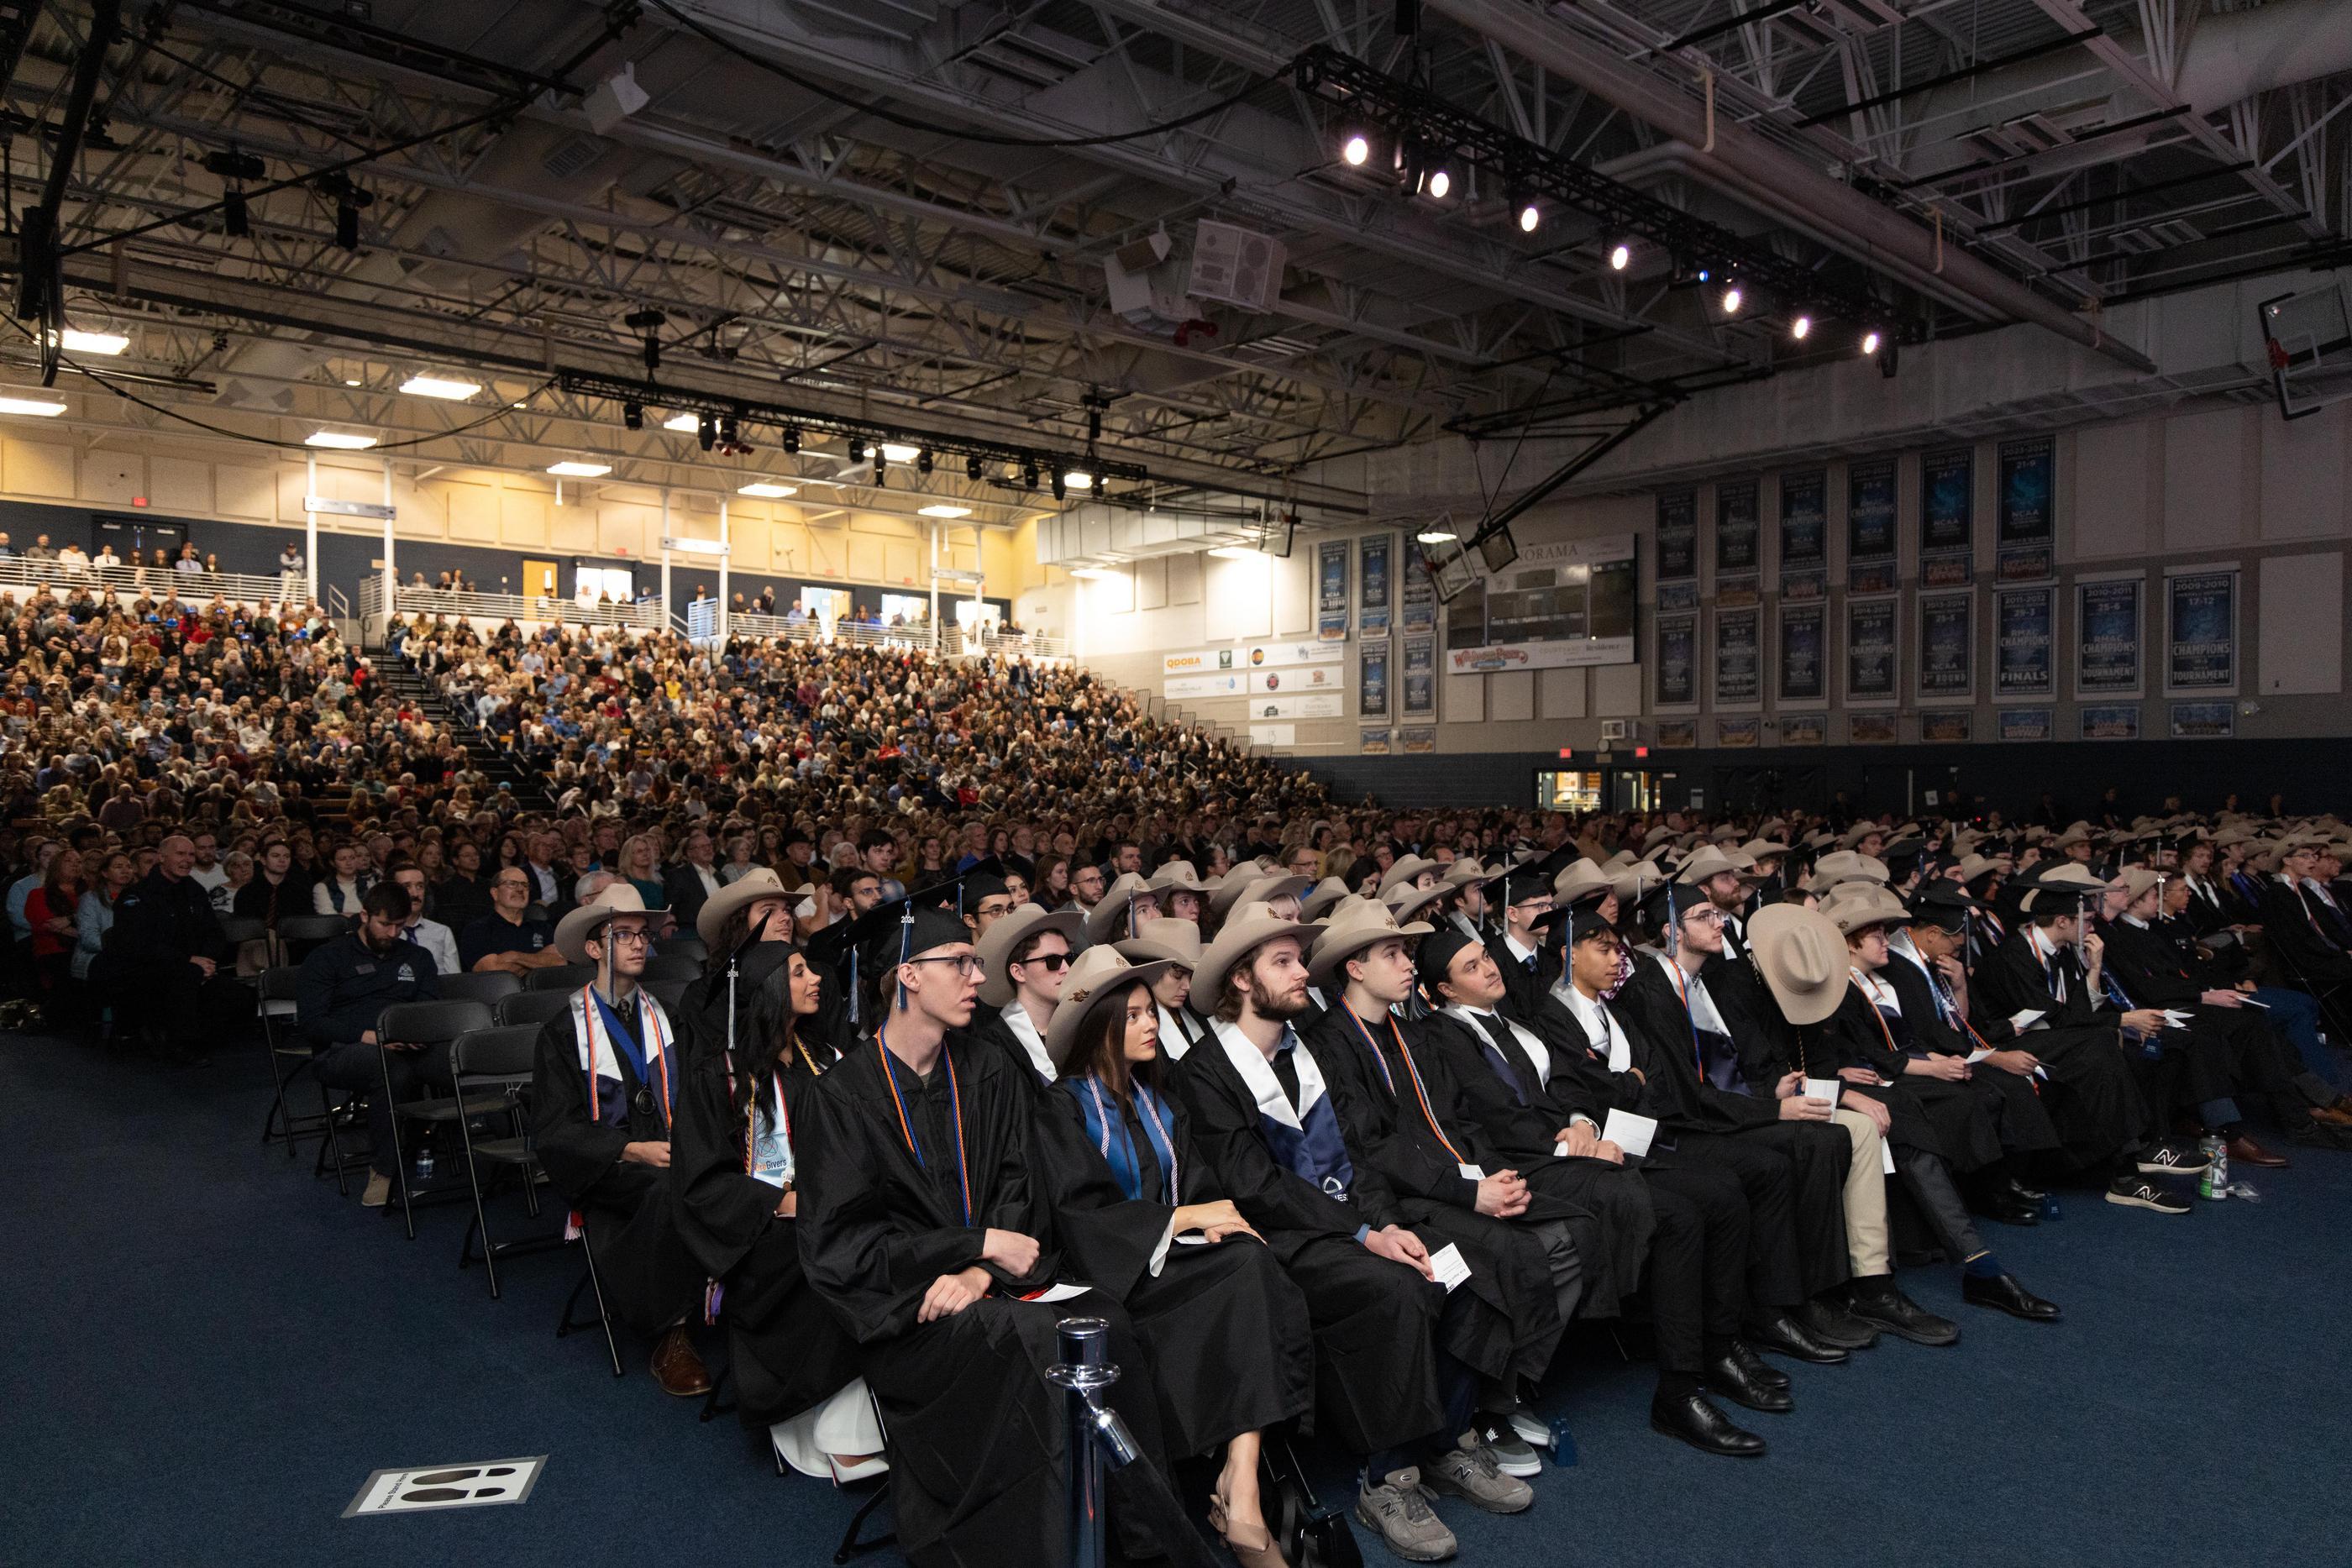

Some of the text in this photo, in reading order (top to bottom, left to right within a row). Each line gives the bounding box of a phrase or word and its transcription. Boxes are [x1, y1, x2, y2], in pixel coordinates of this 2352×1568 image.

[2012, 509, 2039, 518] NCAA
[1934, 518, 1959, 527] NCAA
[1860, 527, 1883, 536] NCAA
[1518, 543, 1579, 562] NORAMA
[2175, 580, 2229, 590] 2009-2010
[2087, 587, 2132, 597] 2010-2011
[2005, 595, 2046, 604] 2011-2012
[2001, 636, 2049, 647] CHAMPIONS
[1719, 646, 1758, 657] CHAMPIONS
[1851, 644, 1894, 655] CHAMPIONS
[2083, 642, 2135, 653] CHAMPIONS
[2174, 643, 2229, 656] CHAMPIONS
[1167, 658, 1201, 669] QDOBA
[1935, 673, 1966, 682] ROUND
[2001, 671, 2048, 681] FINALS
[2083, 667, 2134, 677] TOURNAMENT
[2173, 669, 2229, 680] TOURNAMENT
[900, 915, 915, 924] 2024
[1452, 1464, 1473, 1483] N
[377, 1472, 409, 1508] Please Stand Here
[1378, 1499, 1399, 1518] N
